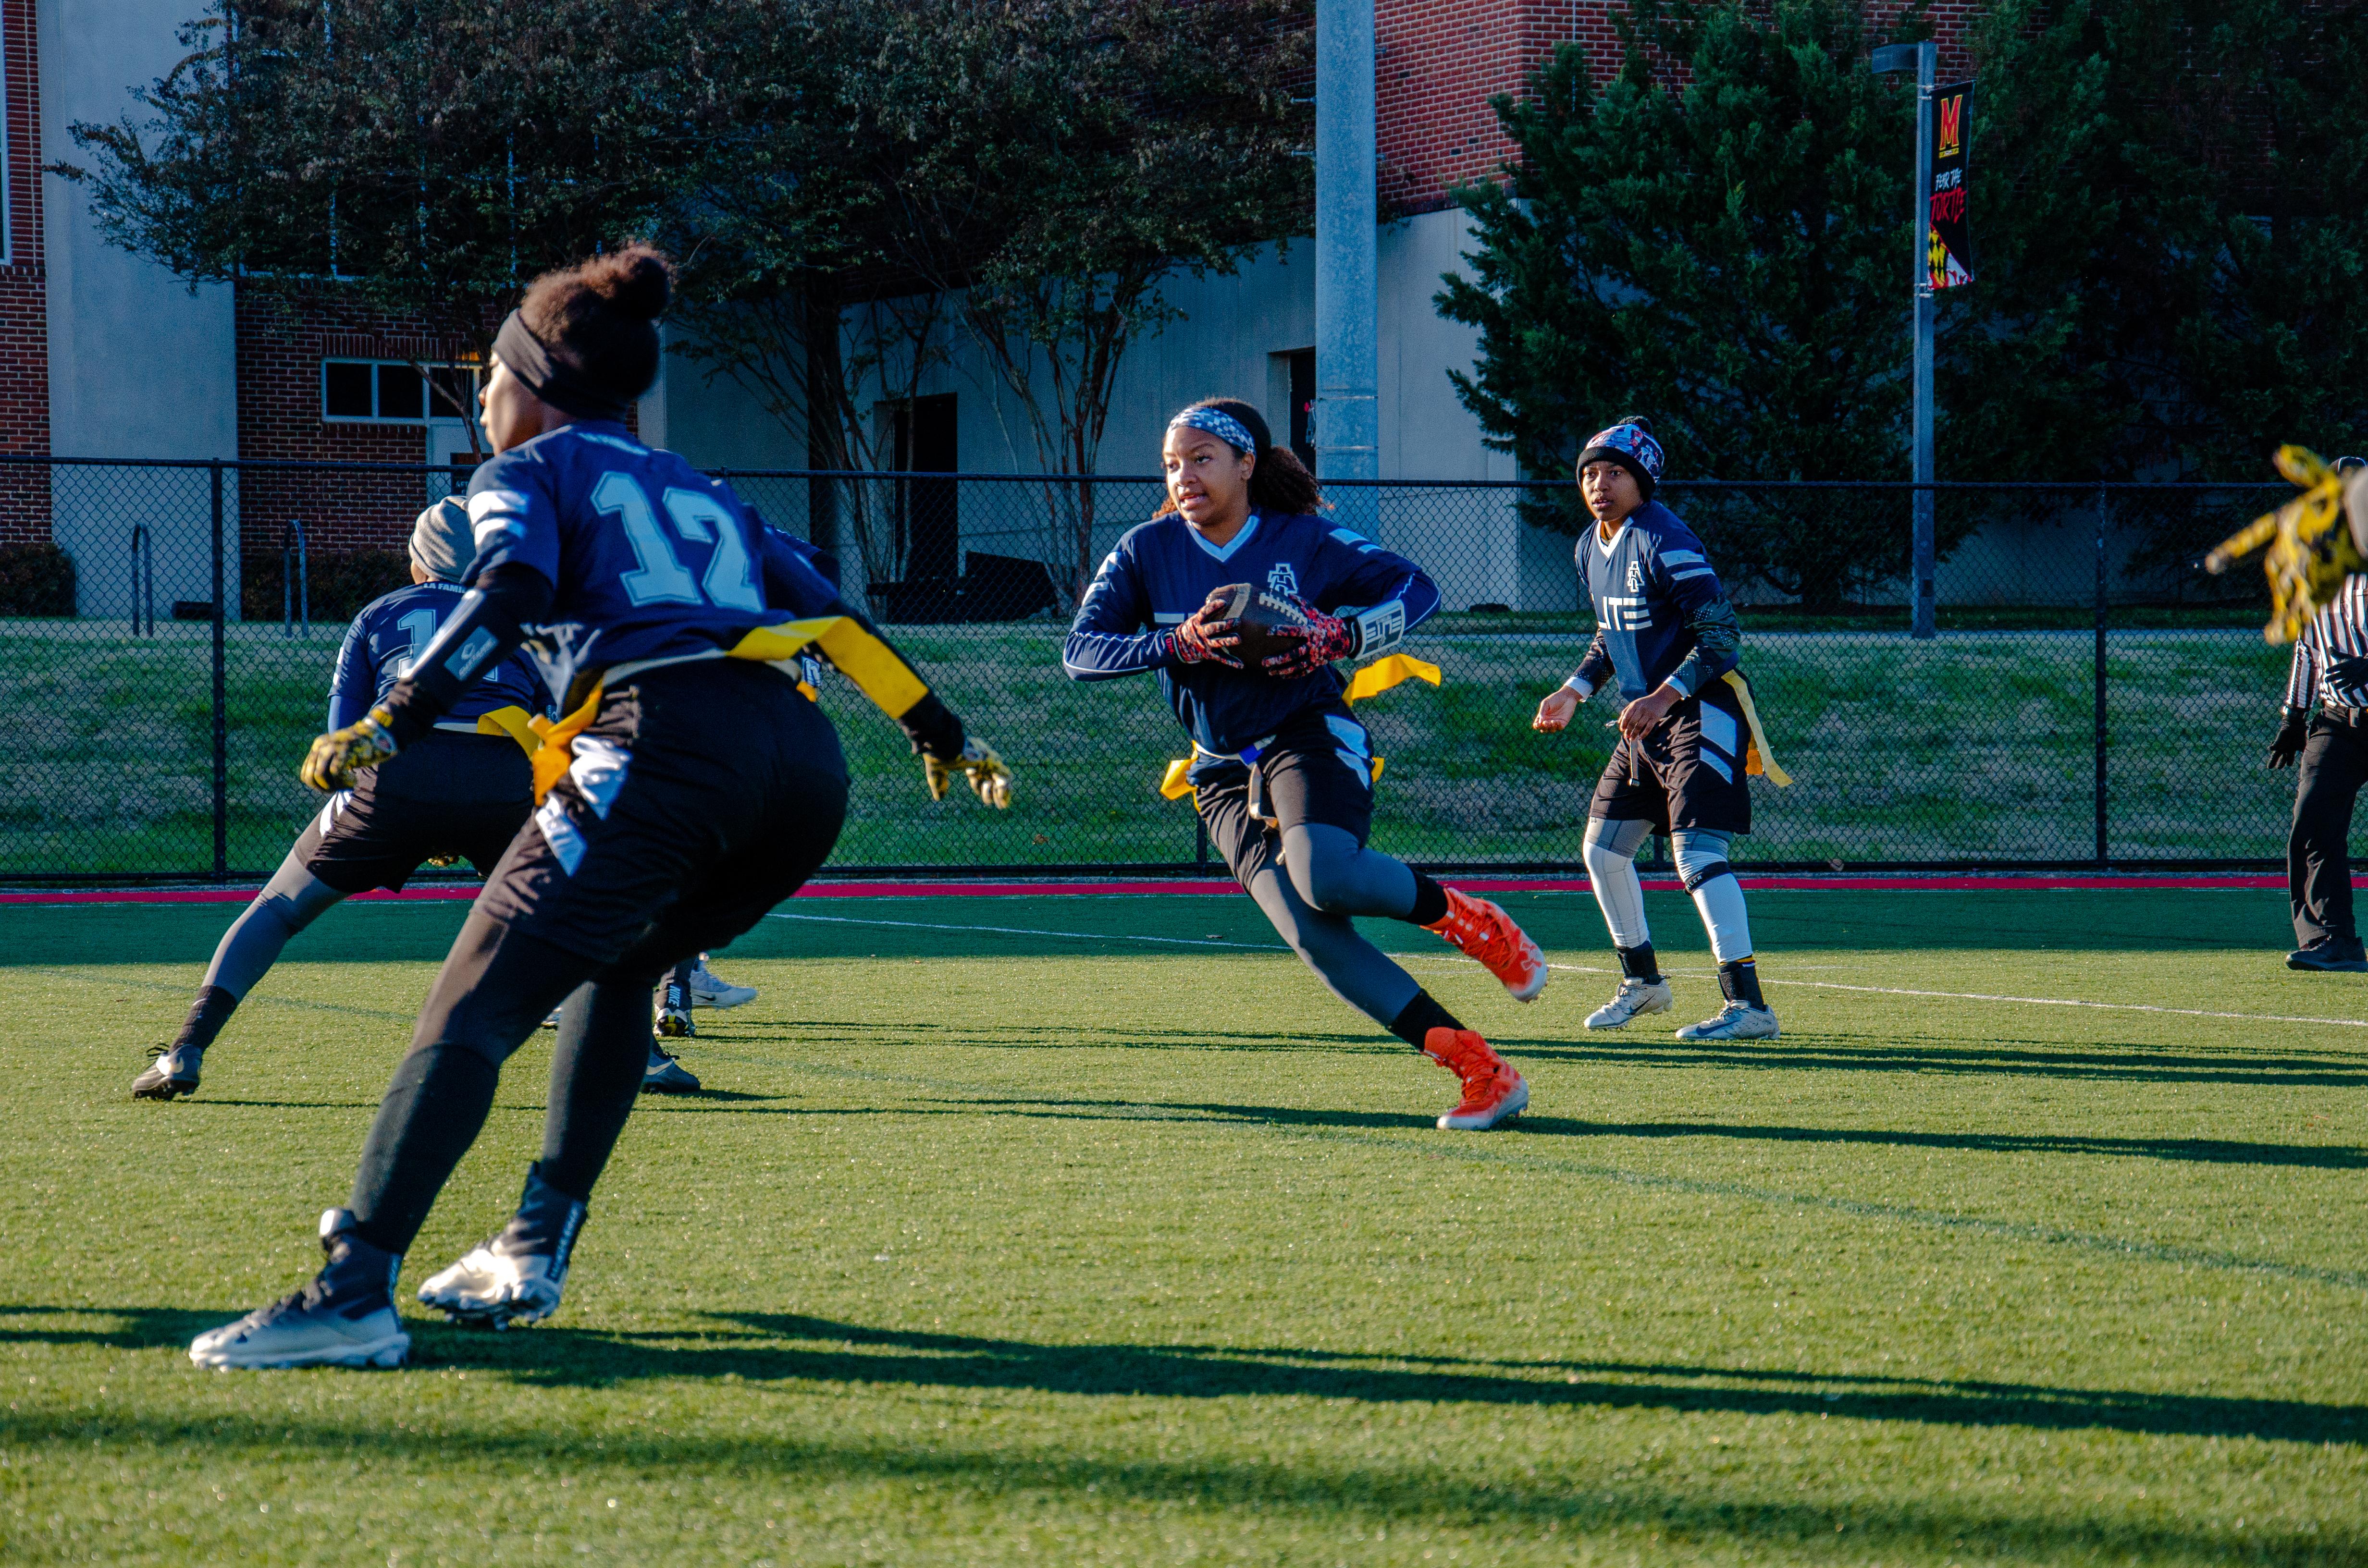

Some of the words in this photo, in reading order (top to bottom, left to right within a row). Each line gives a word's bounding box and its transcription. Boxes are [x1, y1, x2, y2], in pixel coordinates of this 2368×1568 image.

[1939, 95, 1962, 150] M
[1935, 172, 1949, 191] FEAR
[1950, 167, 1962, 189] THE
[1930, 186, 1967, 224] TURTLE
[590, 470, 764, 614] 12
[668, 985, 680, 1007] NIKE
